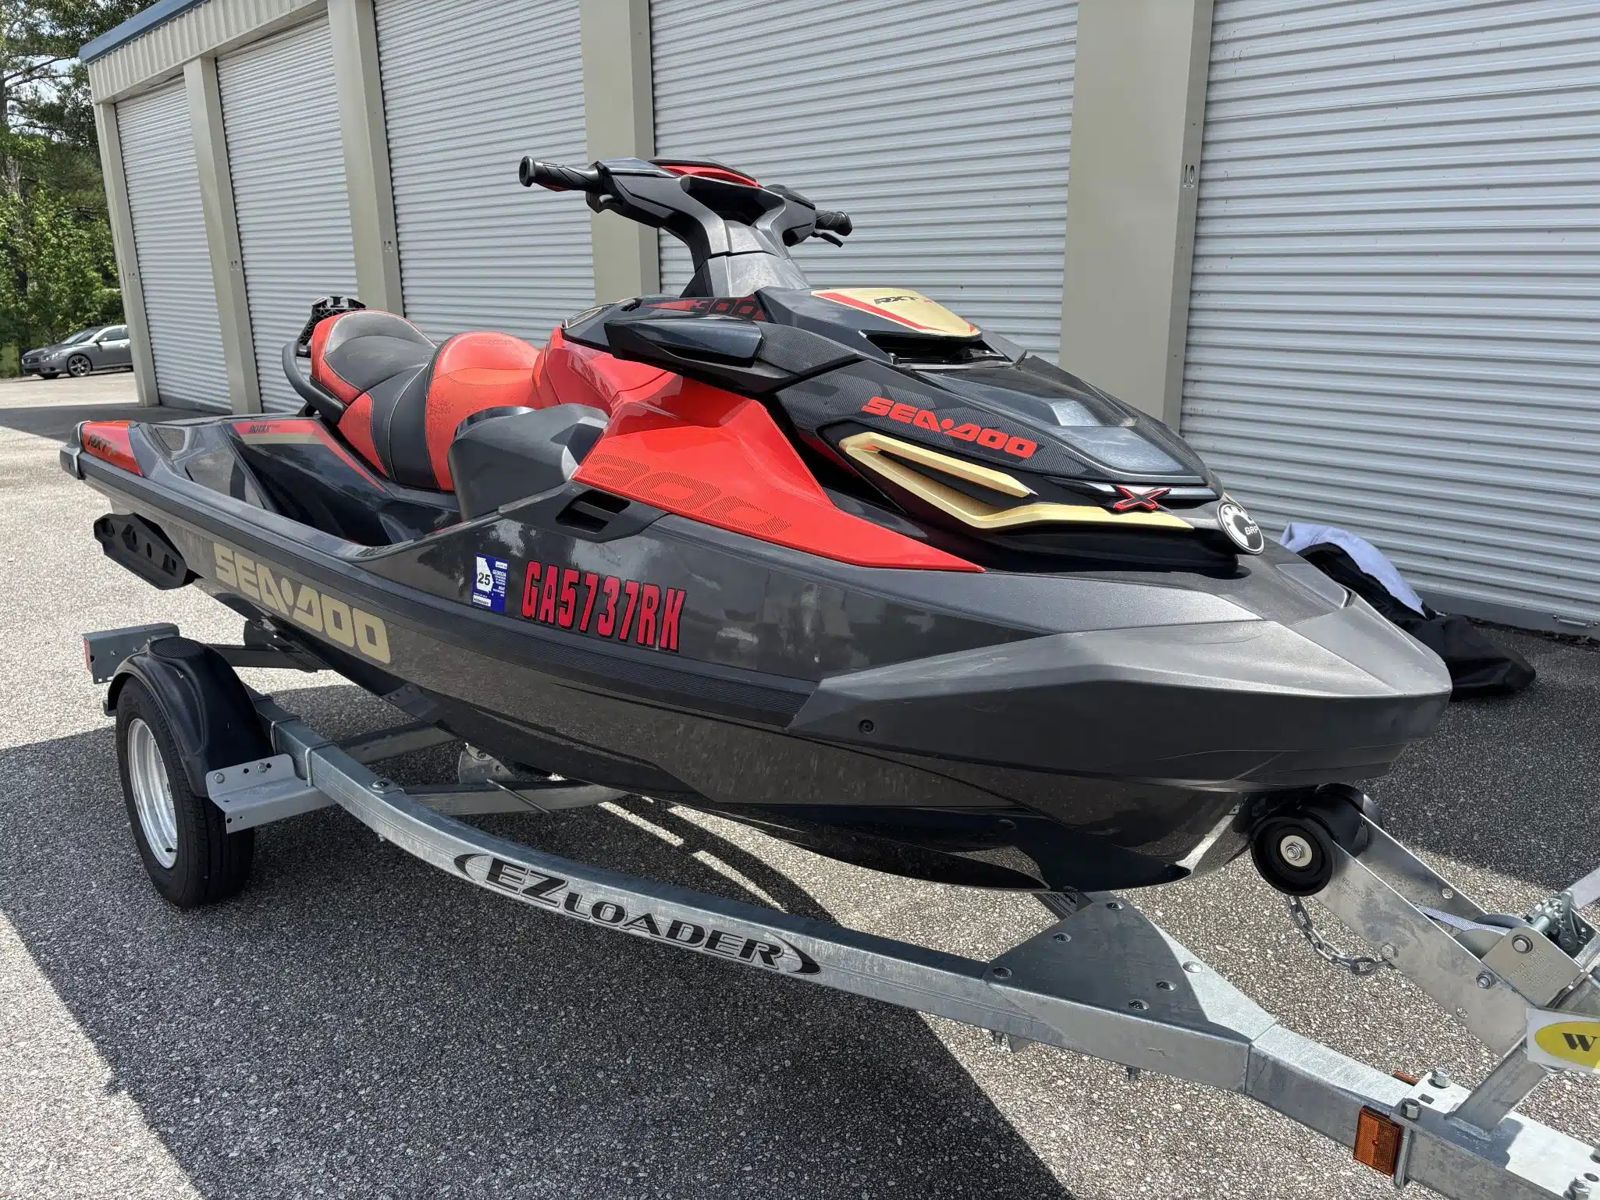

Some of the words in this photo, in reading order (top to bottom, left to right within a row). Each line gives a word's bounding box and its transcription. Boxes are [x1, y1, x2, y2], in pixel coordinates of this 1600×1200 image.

[874, 295, 919, 304] RXT
[1244, 524, 1260, 536] BRP
[478, 572, 491, 586] 25
[521, 560, 687, 652] GA5737RK
